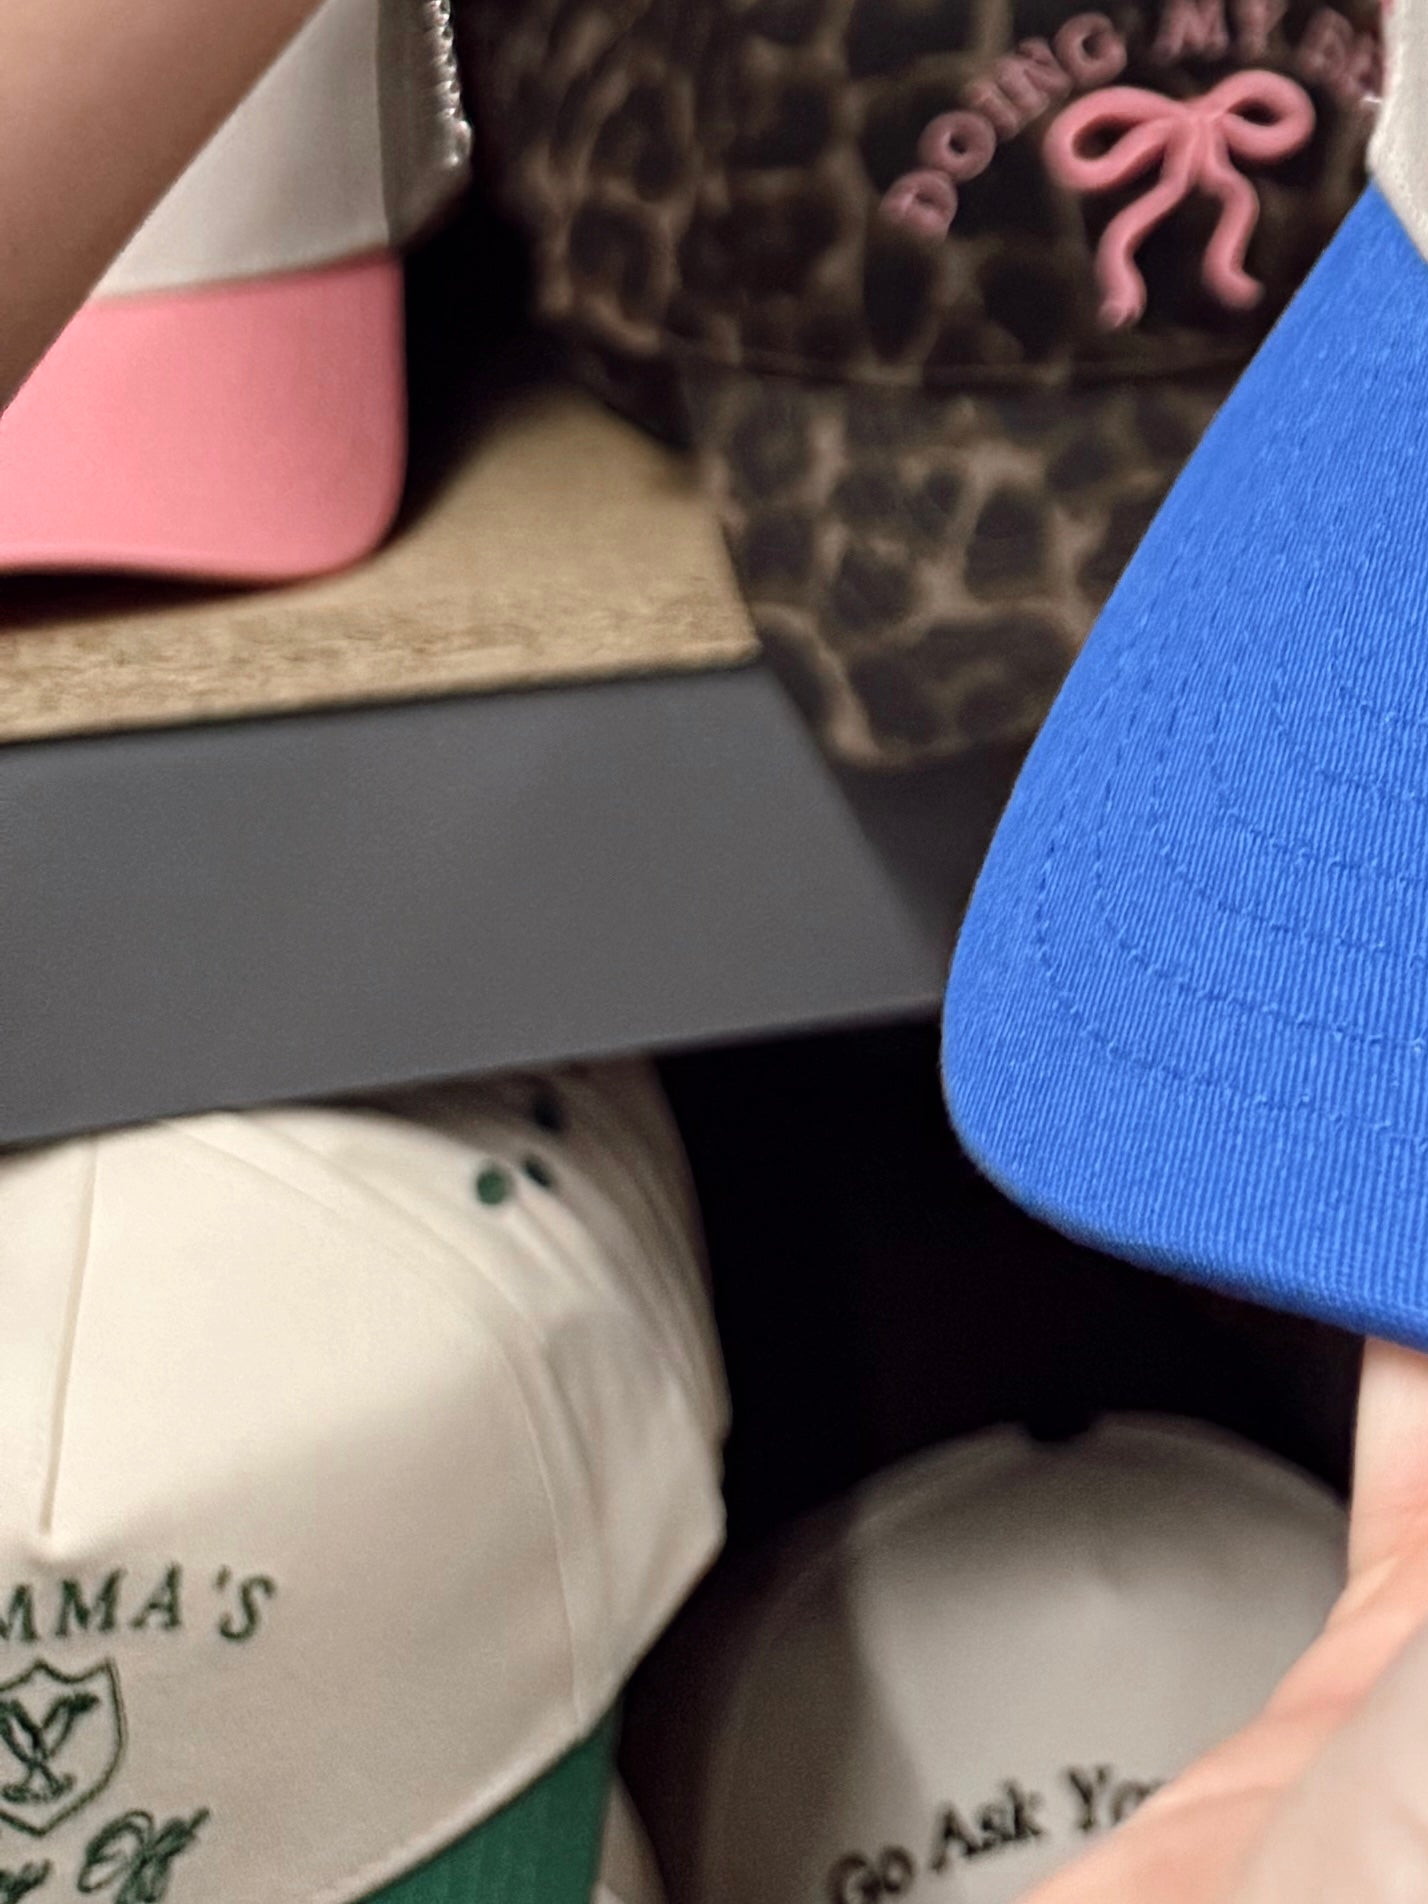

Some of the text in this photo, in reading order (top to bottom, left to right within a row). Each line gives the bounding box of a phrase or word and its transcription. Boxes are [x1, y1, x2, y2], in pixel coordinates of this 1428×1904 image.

[880, 10, 1128, 244] DOING
[828, 1844, 917, 1904] Go
[930, 1780, 1044, 1874] Ask
